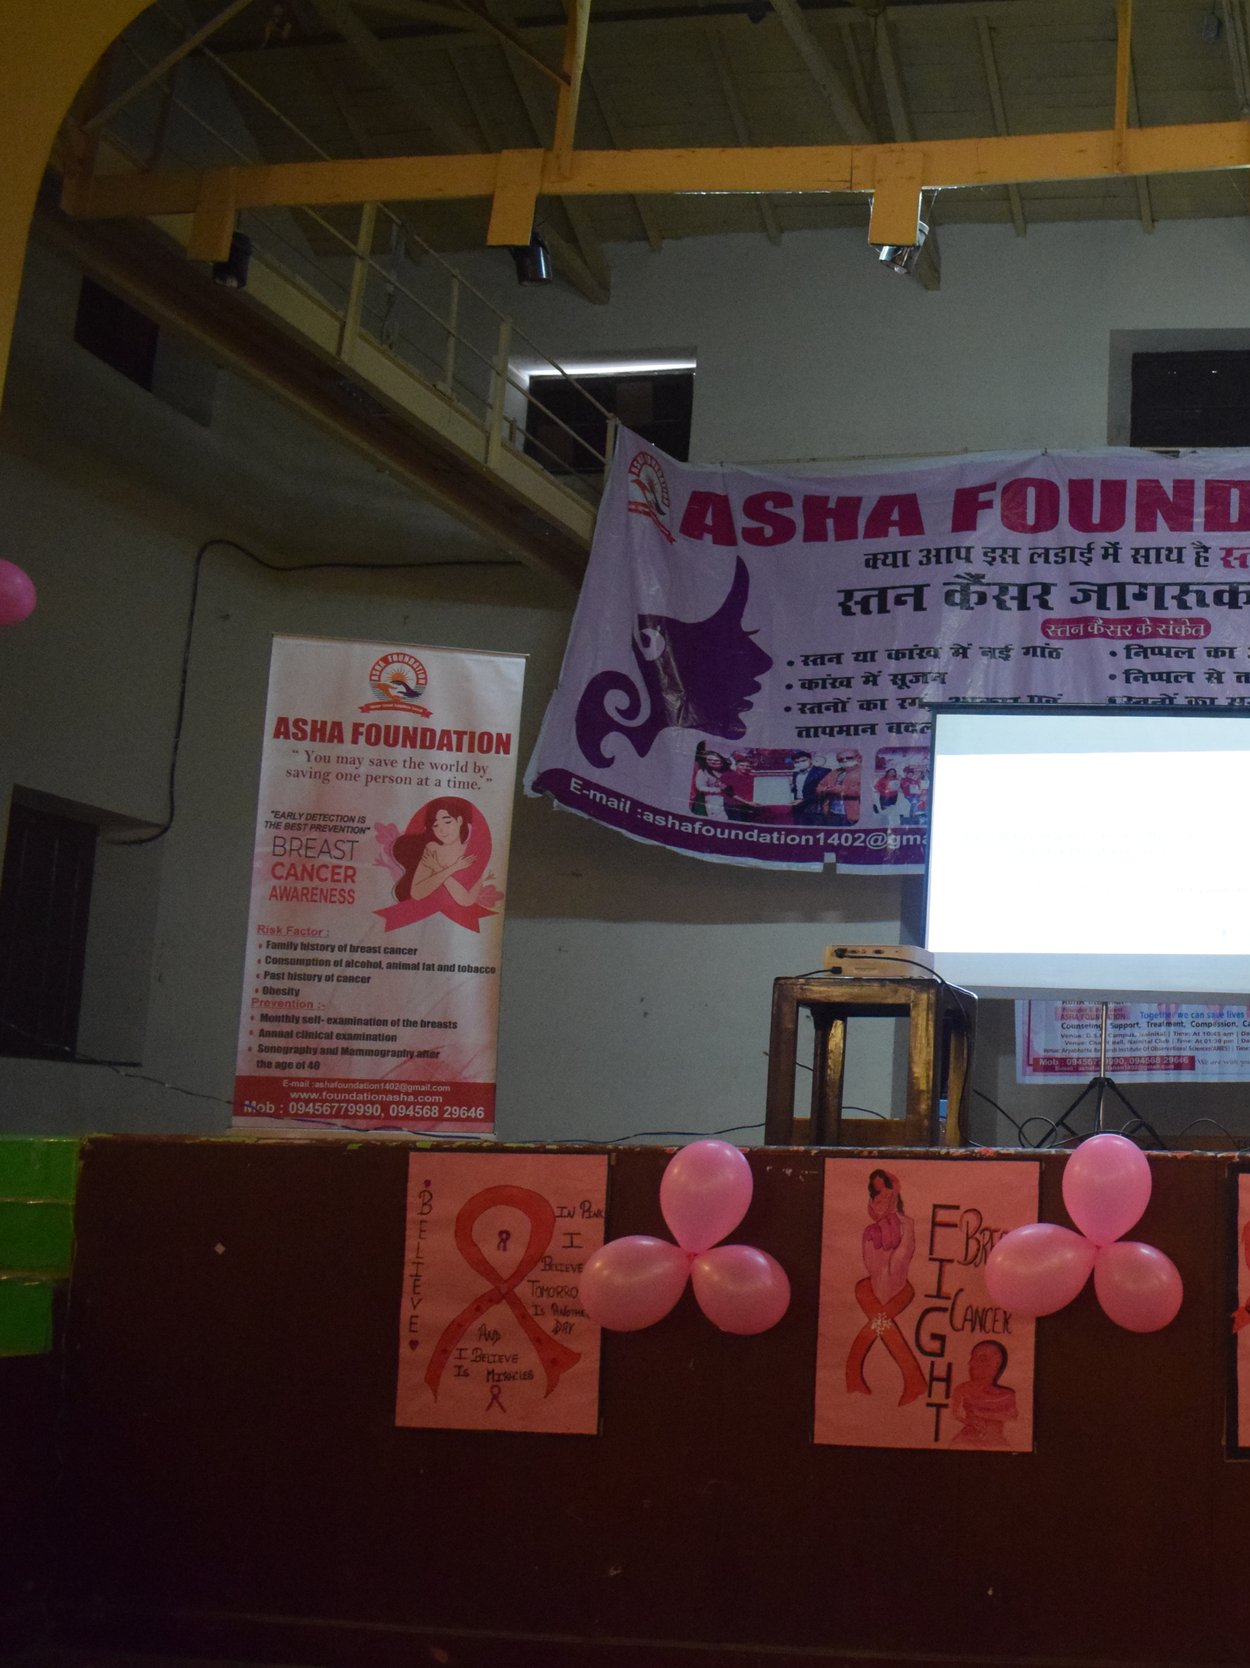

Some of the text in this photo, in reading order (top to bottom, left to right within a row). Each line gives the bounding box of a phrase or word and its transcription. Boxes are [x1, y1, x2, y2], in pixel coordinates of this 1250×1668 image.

[679, 490, 924, 547] ASHA
[864, 549, 911, 569] क्या
[918, 545, 975, 566] आप
[981, 546, 1022, 566] इस
[1100, 541, 1123, 563] में
[1130, 546, 1187, 564] साथ
[836, 583, 931, 617] स्तन
[1045, 623, 1084, 637] स्तन
[1135, 617, 1153, 636] के
[800, 653, 844, 666] स्तन
[852, 650, 878, 663] या
[1123, 643, 1196, 660] निप्पल
[1204, 646, 1238, 659] का
[861, 670, 882, 687] में
[1123, 668, 1195, 684] निप्पल
[857, 698, 889, 711] का
[272, 716, 513, 755] ASHA FOUNDATION
[795, 722, 879, 738] तापमान
[336, 755, 364, 769] may
[368, 757, 398, 768] save
[403, 757, 425, 770] the
[430, 760, 469, 773] world
[473, 761, 489, 778] by
[285, 767, 332, 784] saving
[335, 770, 361, 782] one
[364, 773, 412, 787] person
[416, 776, 430, 786] at
[434, 779, 441, 787] a
[568, 777, 631, 814] E-mail
[264, 820, 283, 830] THE
[283, 822, 309, 832] BEST
[305, 812, 355, 823] DETECTION
[357, 815, 367, 824] IS
[272, 836, 359, 861] BREAST
[271, 862, 357, 884] CANCER
[268, 884, 356, 905] AWARENESS
[257, 923, 323, 937] Risk Factor
[266, 940, 418, 956] Family history of breast cancer
[264, 955, 331, 967] Consumption
[333, 958, 343, 968] of
[385, 960, 421, 971] animal
[422, 962, 436, 972] fat
[437, 963, 456, 973] and
[457, 964, 497, 974] tobacco
[263, 970, 372, 984] Past history of cancer
[262, 985, 301, 997] Obesity
[250, 997, 314, 1010] Prevention
[260, 1013, 300, 1025] Monthly
[326, 1015, 389, 1027] examination
[390, 1018, 400, 1028] of
[402, 1018, 419, 1028] the
[420, 1019, 458, 1030] breasts
[1190, 1011, 1205, 1019] can
[1226, 1010, 1245, 1019] lives
[258, 1028, 397, 1042] Annual clinical examination
[319, 1046, 339, 1056] and
[256, 1059, 273, 1069] the
[274, 1060, 294, 1070] age
[295, 1061, 305, 1070] of
[282, 1079, 311, 1089] E-mail
[289, 1090, 443, 1104] www.foundationasha.com
[243, 1100, 275, 1114] Mob
[389, 1104, 439, 1118] 094568
[443, 1105, 485, 1119] 29646
